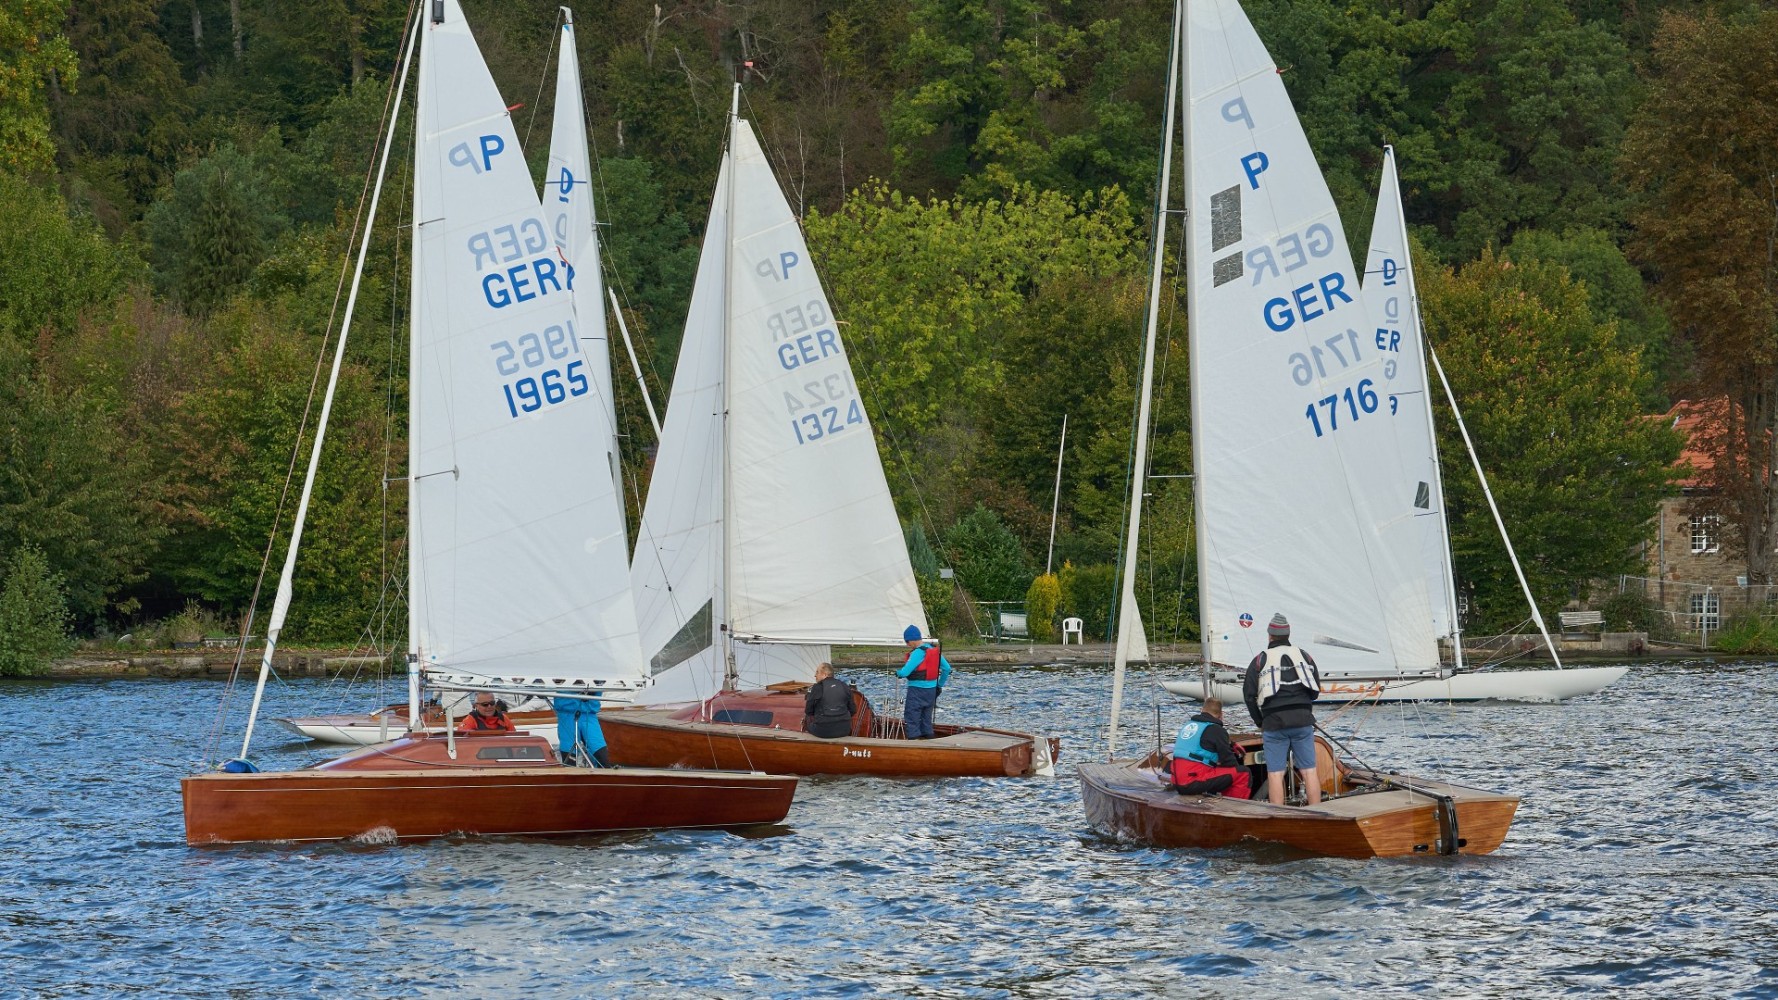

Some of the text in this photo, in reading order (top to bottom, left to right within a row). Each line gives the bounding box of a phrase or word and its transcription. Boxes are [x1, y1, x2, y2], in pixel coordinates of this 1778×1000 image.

[479, 134, 505, 171] P
[1240, 151, 1270, 190] P
[560, 167, 574, 195] D
[481, 257, 562, 309] GER
[780, 251, 799, 280] P
[1383, 258, 1397, 280] D
[1263, 272, 1354, 332] GER
[777, 329, 840, 371] GER
[1375, 327, 1401, 353] ER
[503, 359, 589, 419] 1965
[1304, 378, 1379, 438] 1716
[792, 398, 864, 446] 1324
